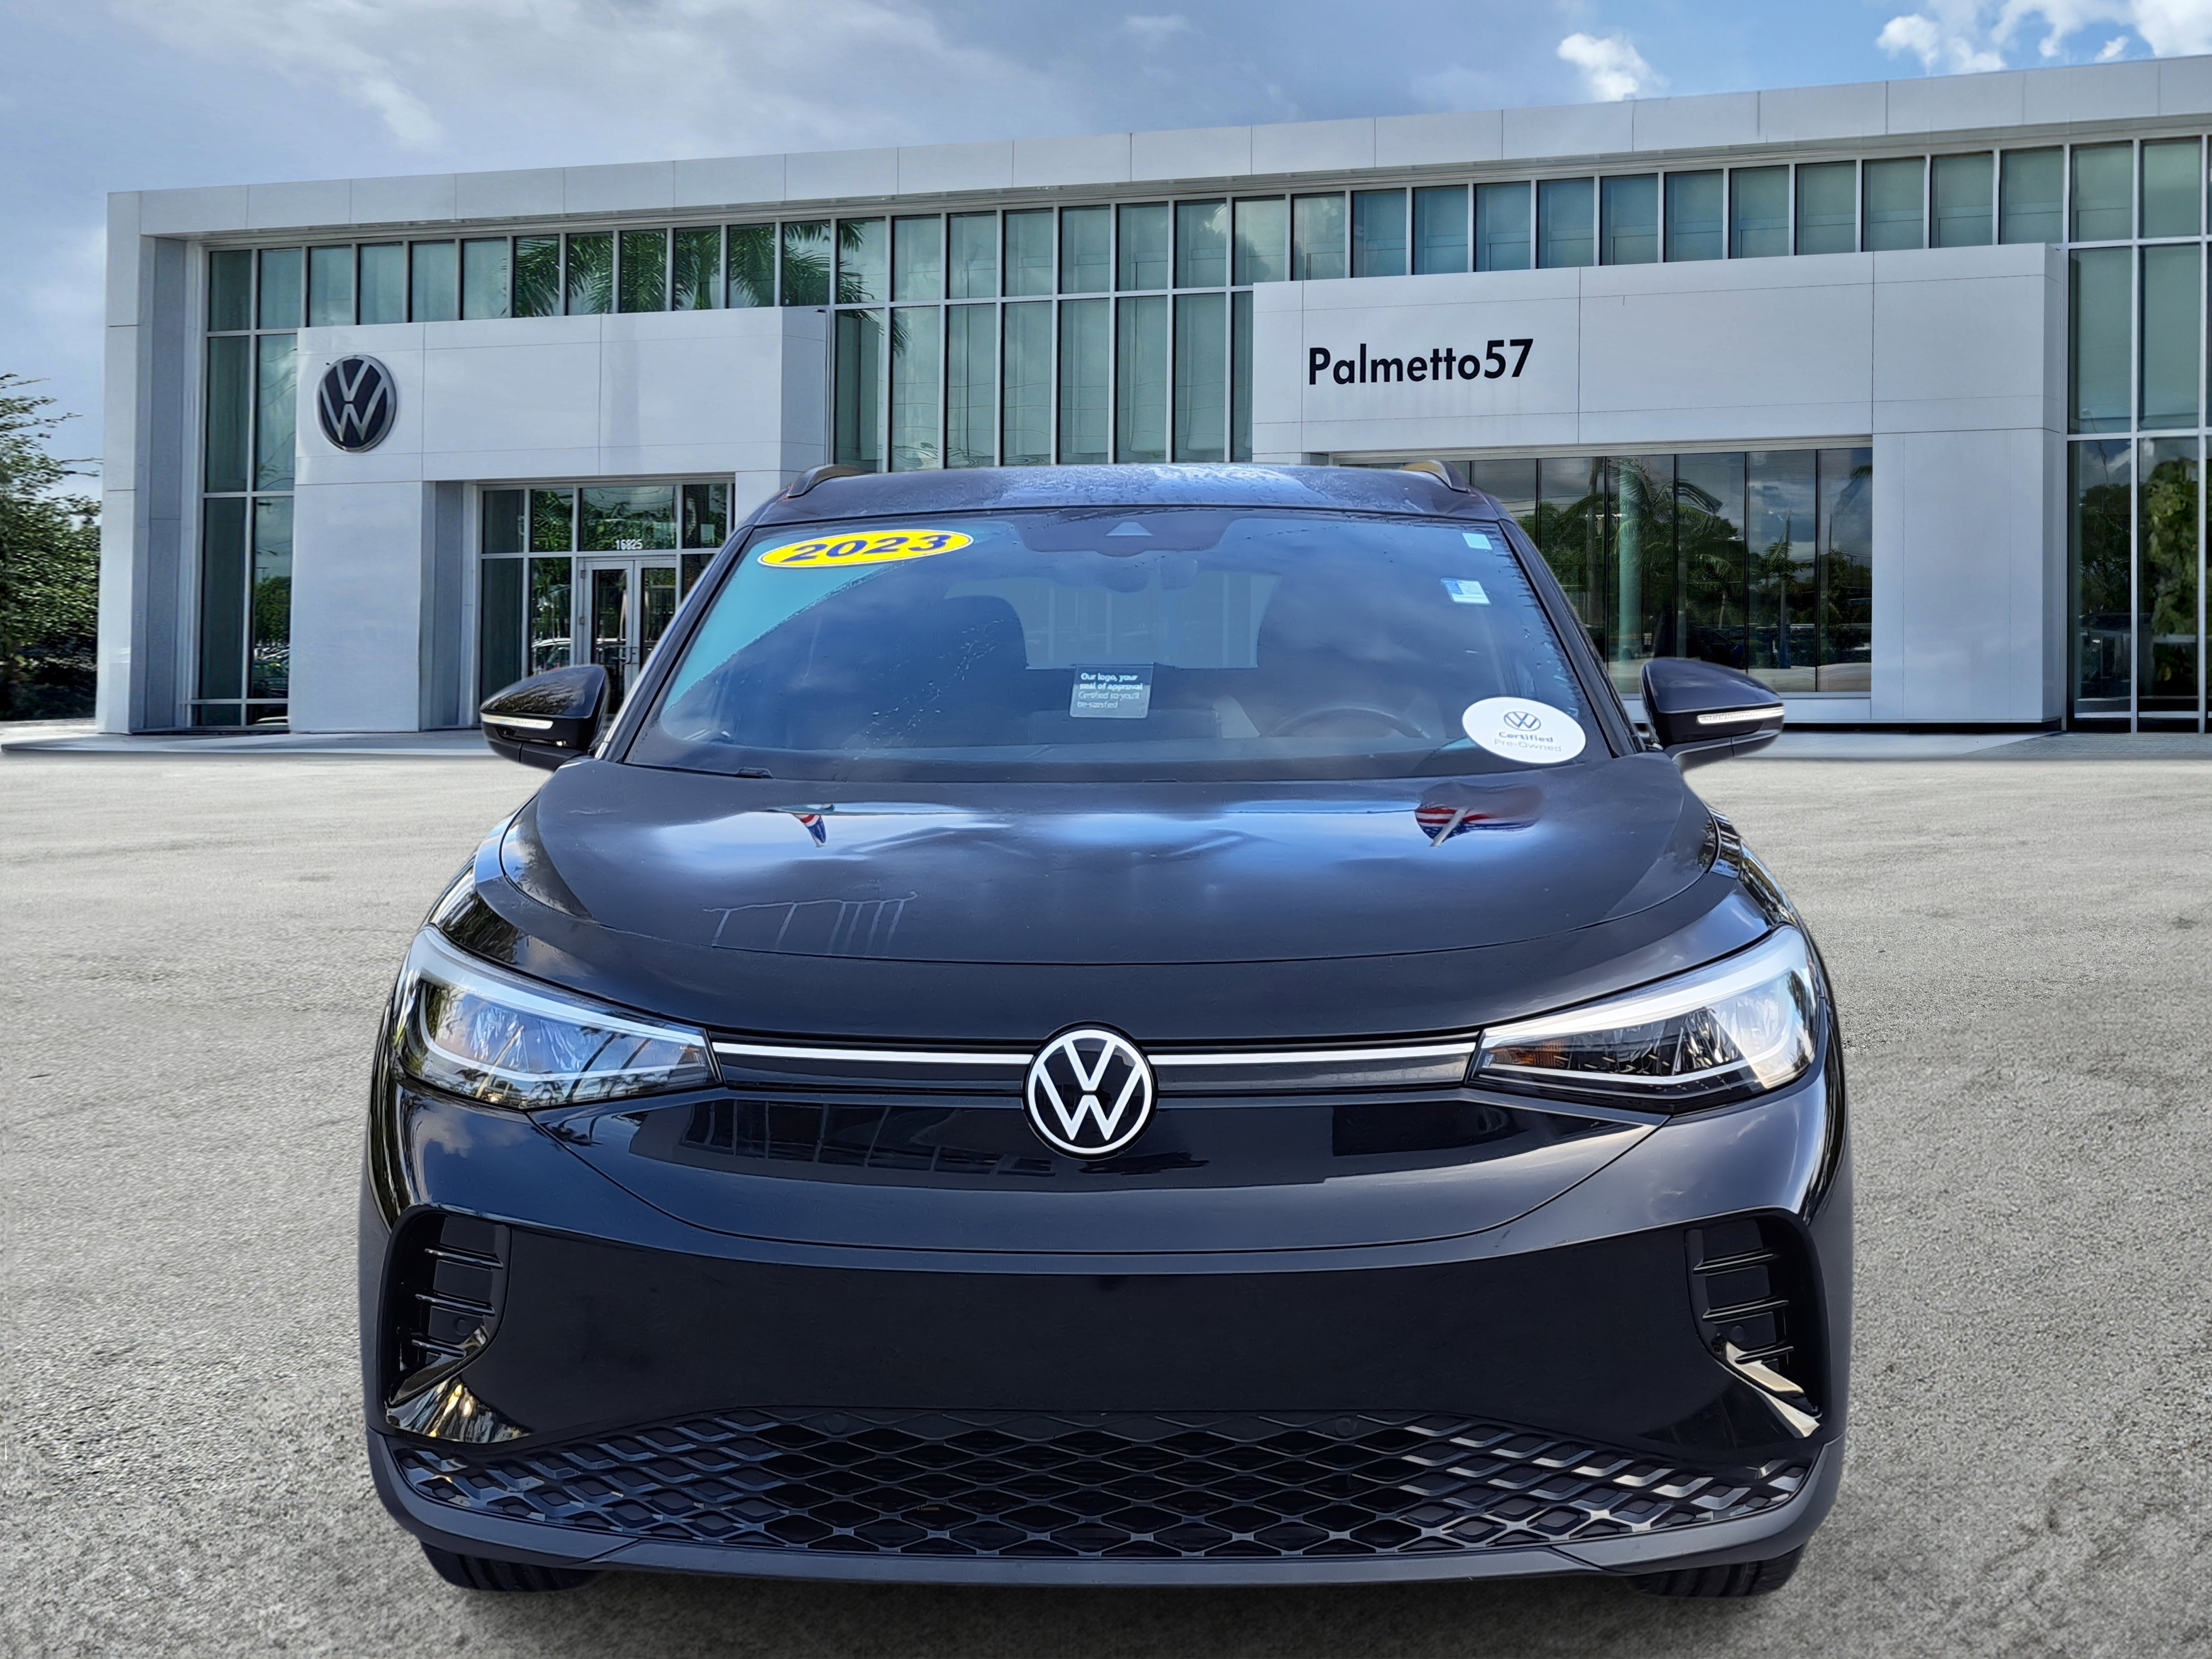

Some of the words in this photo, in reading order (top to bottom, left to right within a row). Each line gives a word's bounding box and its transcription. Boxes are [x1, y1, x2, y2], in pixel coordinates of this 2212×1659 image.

[1308, 338, 1534, 385] Palmetto57
[780, 534, 952, 562] 2023
[1080, 672, 1096, 680] Our
[1098, 682, 1107, 690] of
[1498, 731, 1554, 743] Certified
[1494, 738, 1562, 752] Pre-Owned
[1032, 1034, 1148, 1148] VW
